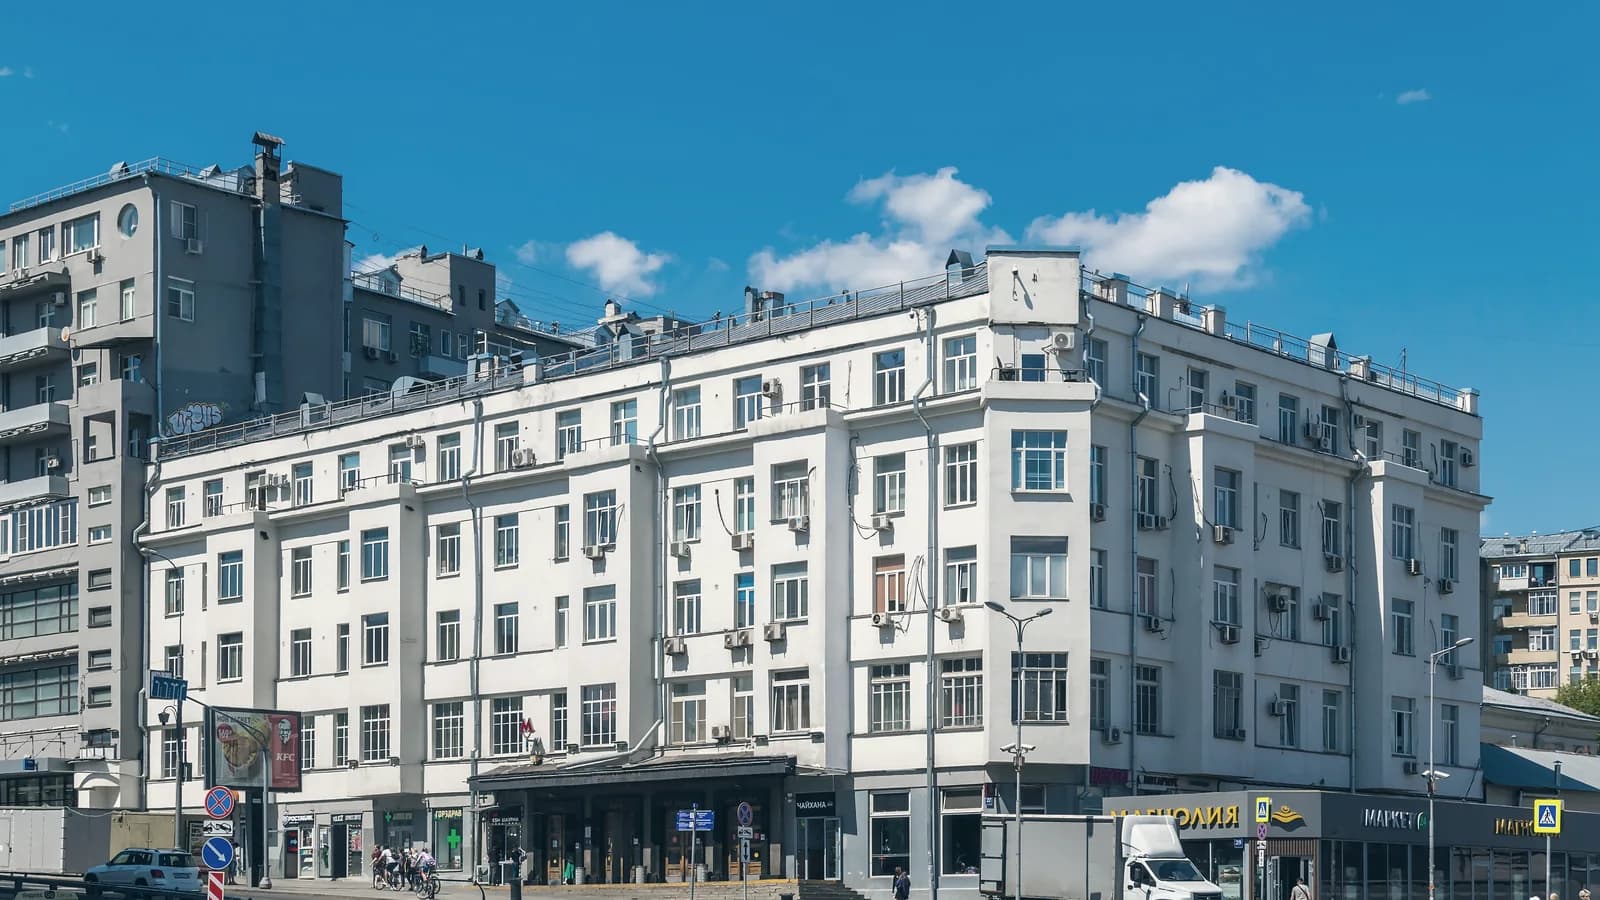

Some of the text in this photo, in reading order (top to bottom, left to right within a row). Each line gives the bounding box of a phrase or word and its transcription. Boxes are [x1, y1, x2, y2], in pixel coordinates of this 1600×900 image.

[276, 752, 296, 761] KFC
[796, 800, 827, 809] ЧАЙХАНА
[1364, 808, 1414, 829] МАРКЕТ
